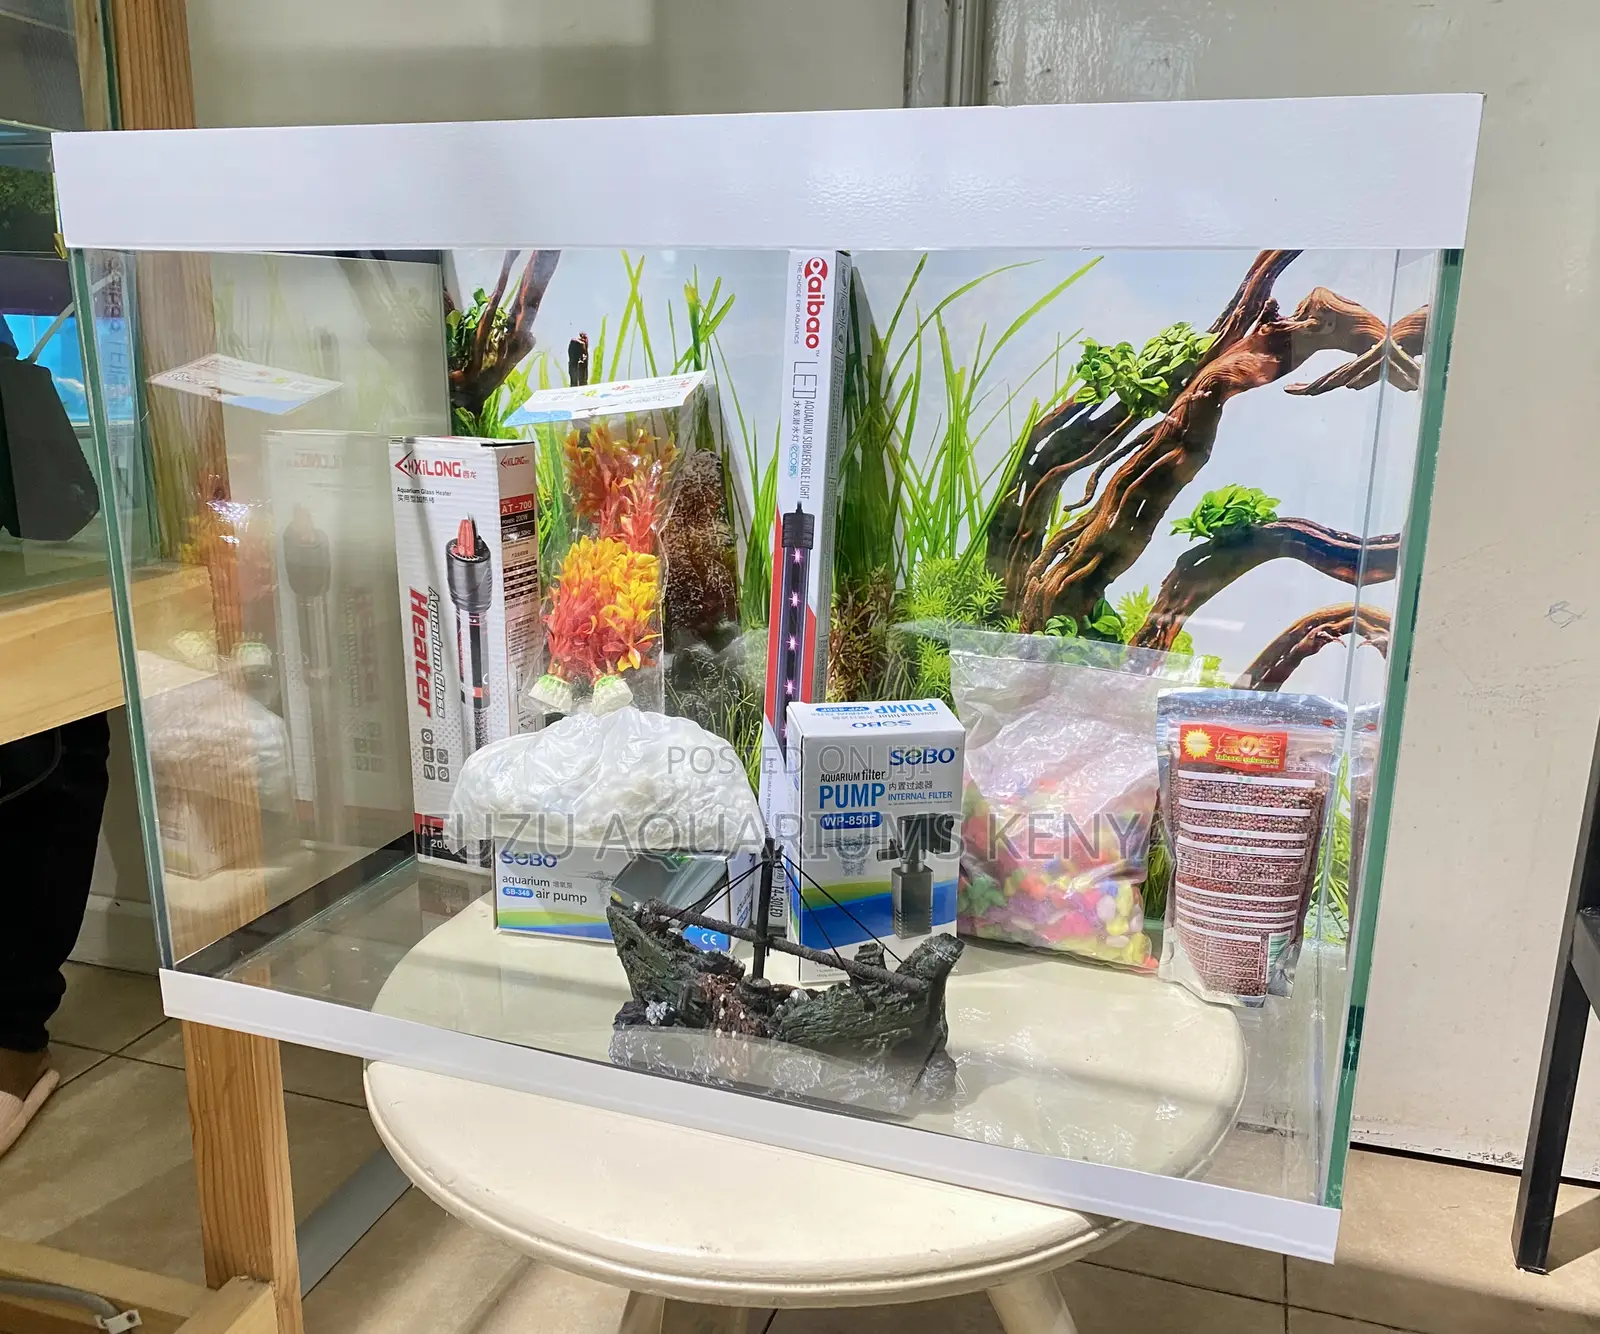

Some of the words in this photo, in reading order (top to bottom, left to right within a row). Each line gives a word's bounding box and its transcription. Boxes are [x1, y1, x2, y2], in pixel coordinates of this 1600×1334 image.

[792, 361, 818, 399] LED
[803, 400, 815, 435] AQUARIUM
[801, 436, 813, 479] SUBMERSIBLE
[397, 486, 420, 496] Aquarium
[421, 488, 435, 496] Glass
[800, 480, 810, 500] LIGHT
[428, 586, 443, 672] Aquarium
[410, 588, 431, 719] Heater
[434, 672, 446, 718] Glass
[874, 703, 937, 714] PUMP
[889, 748, 955, 766] SOBO
[820, 772, 860, 782] AQUARIUM
[861, 769, 886, 780] filter
[888, 781, 933, 791] 内置过滤器
[819, 783, 886, 809] PUMP
[888, 792, 926, 801] INTERNAL
[928, 791, 953, 799] FILTER
[824, 815, 877, 826] WP-850F
[502, 876, 550, 887] aquarium
[535, 889, 550, 899] air
[553, 892, 587, 905] pump
[701, 933, 717, 945] CE
